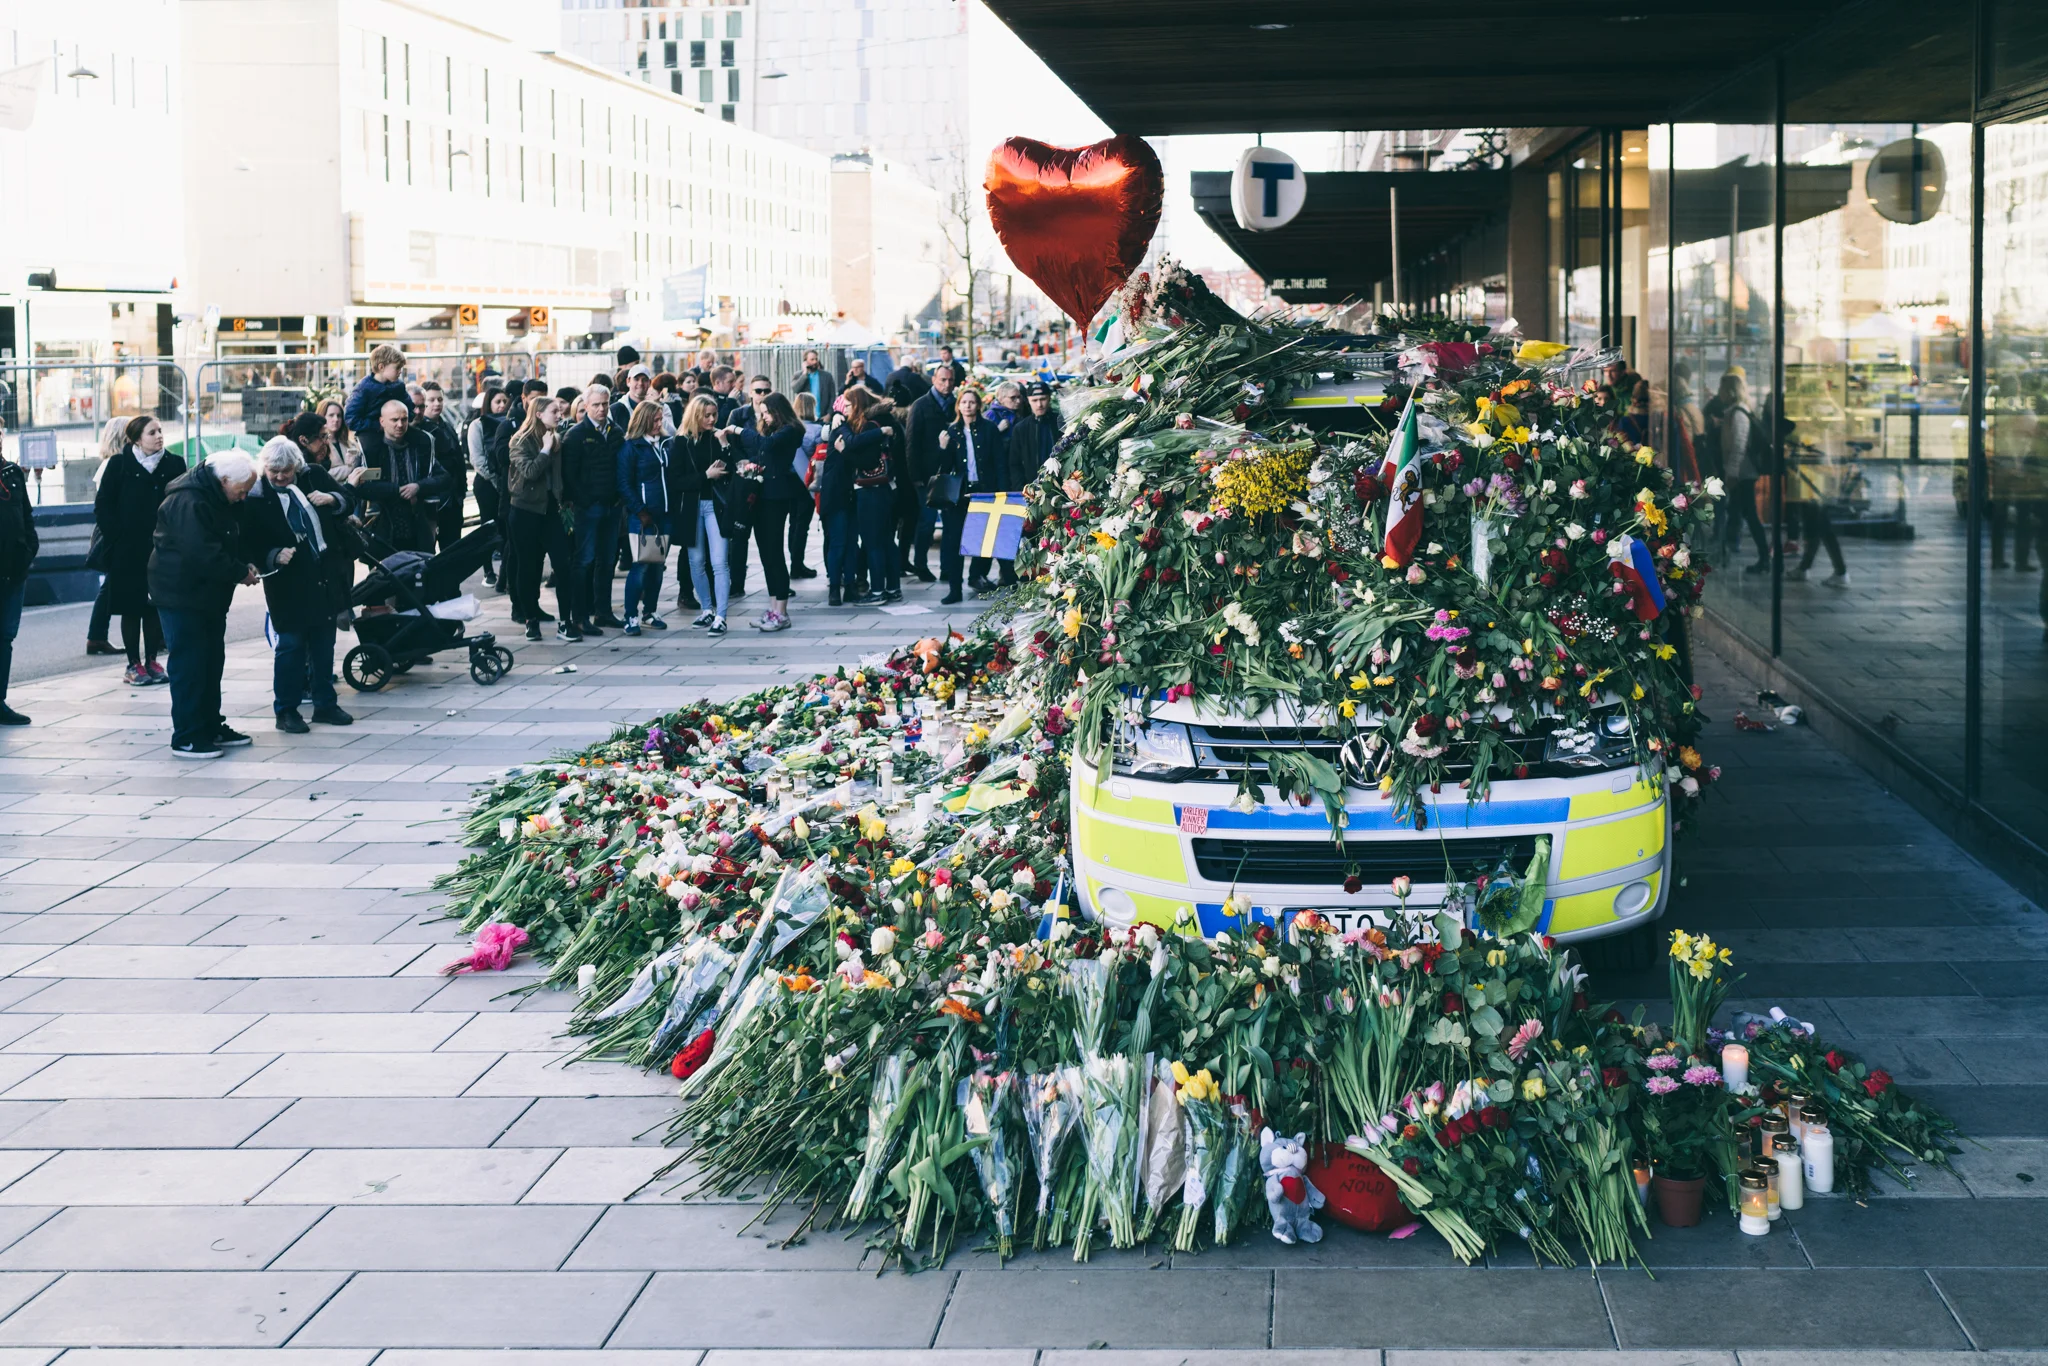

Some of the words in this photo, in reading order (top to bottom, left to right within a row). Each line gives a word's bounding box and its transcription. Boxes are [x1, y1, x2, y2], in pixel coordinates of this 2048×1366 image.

[1251, 161, 1294, 217] T
[1271, 278, 1285, 290] JOE
[1290, 278, 1305, 290] THE
[1306, 277, 1328, 289] JUICE
